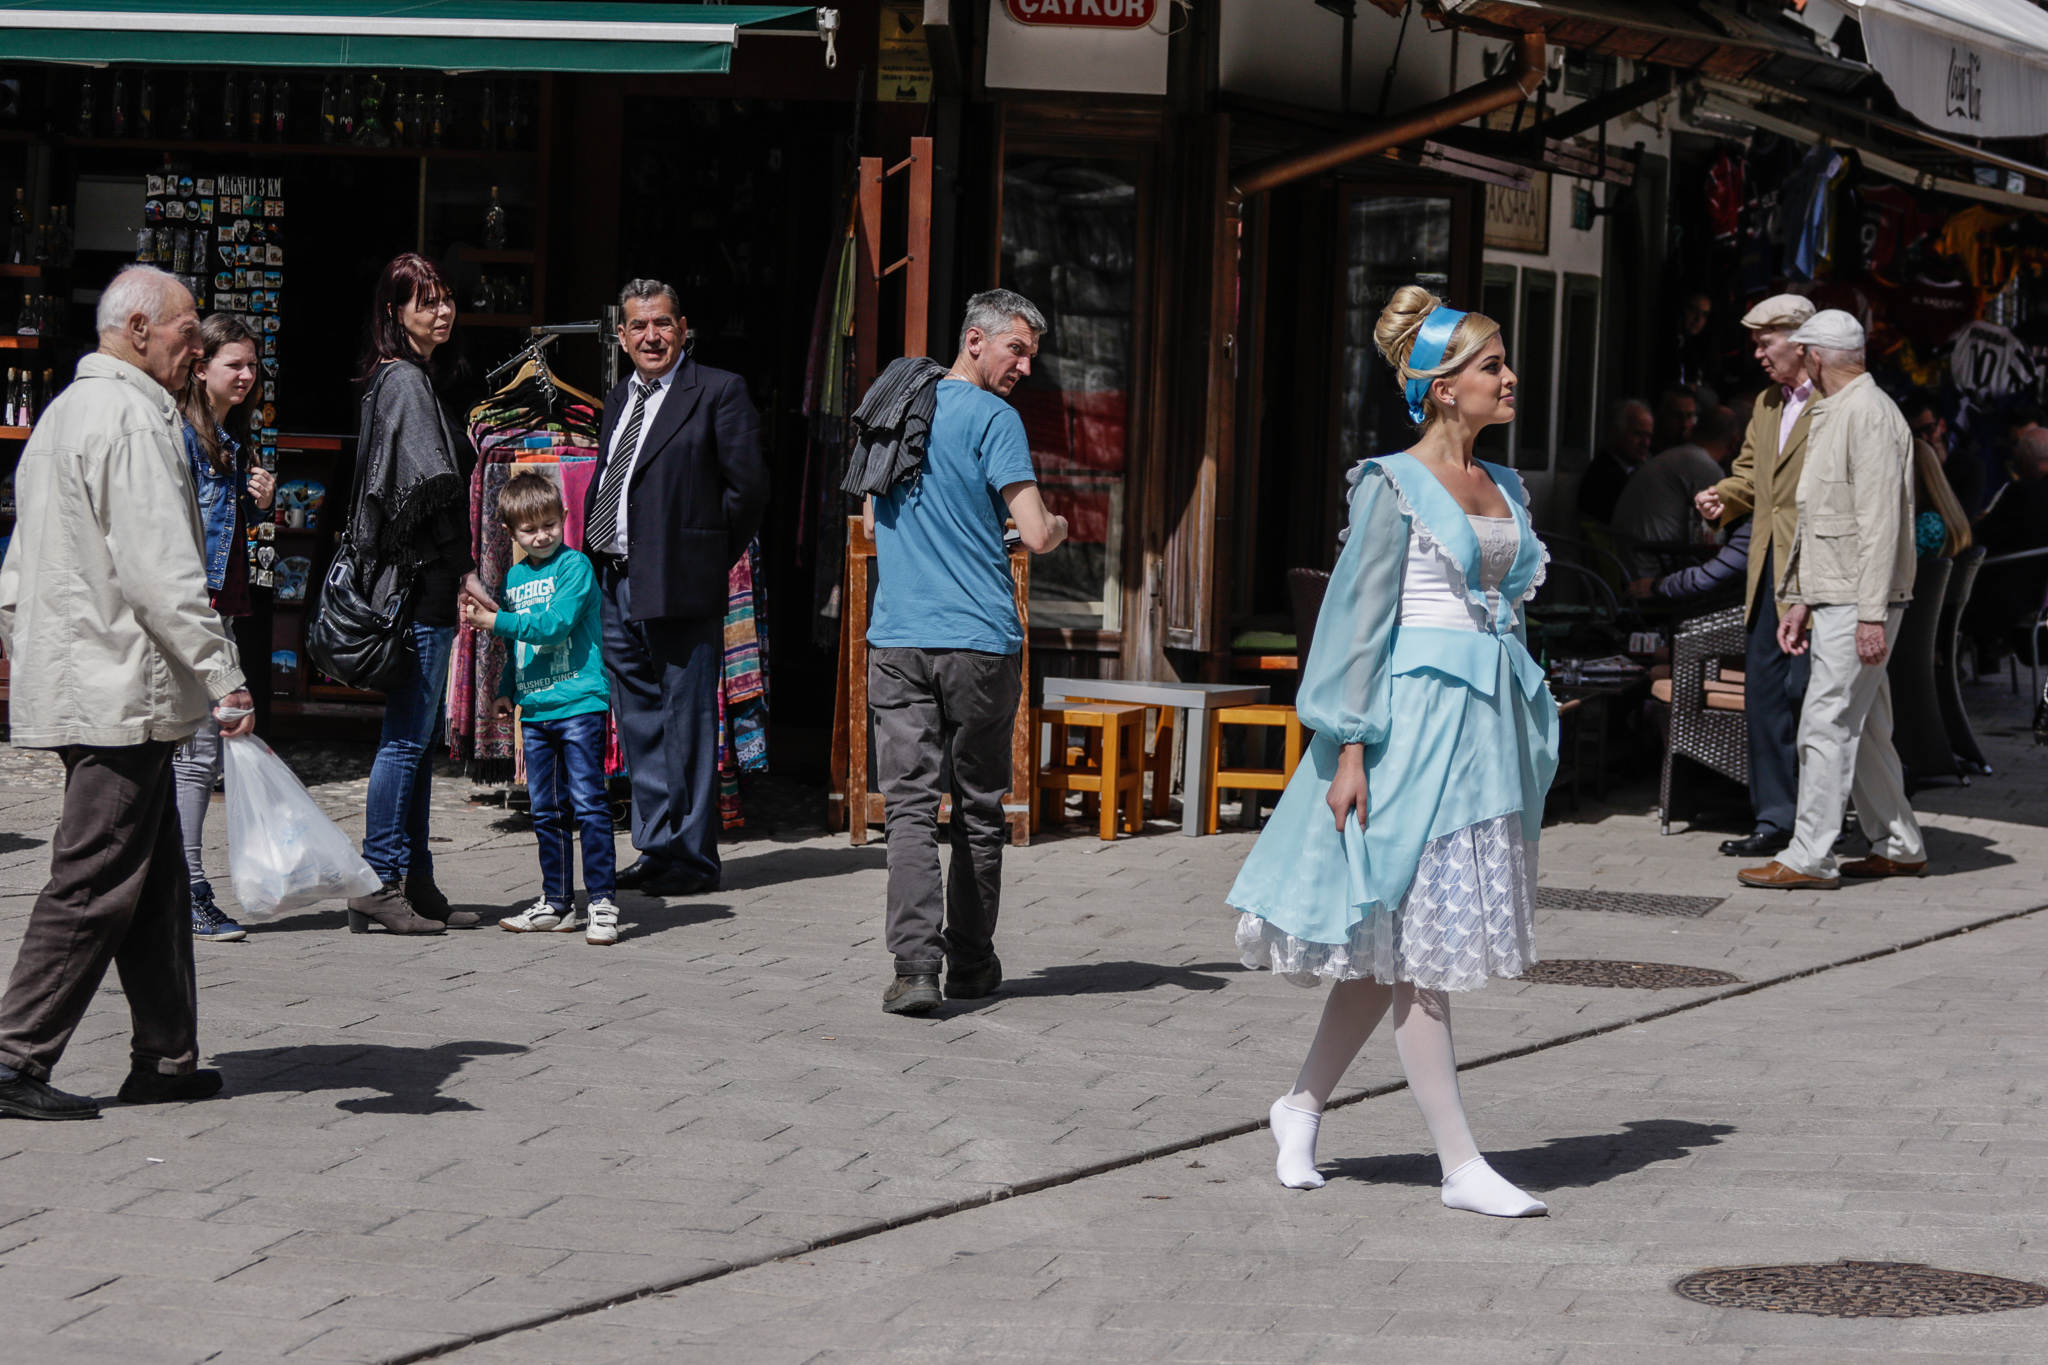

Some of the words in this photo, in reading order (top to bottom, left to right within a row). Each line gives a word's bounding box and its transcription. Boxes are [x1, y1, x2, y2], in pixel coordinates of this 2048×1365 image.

[259, 177, 266, 197] 3
[267, 178, 281, 198] KM
[1860, 224, 1878, 255] 9
[1971, 343, 1997, 387] 10
[504, 576, 558, 604] MICHIGA
[553, 670, 579, 684] SINCE
